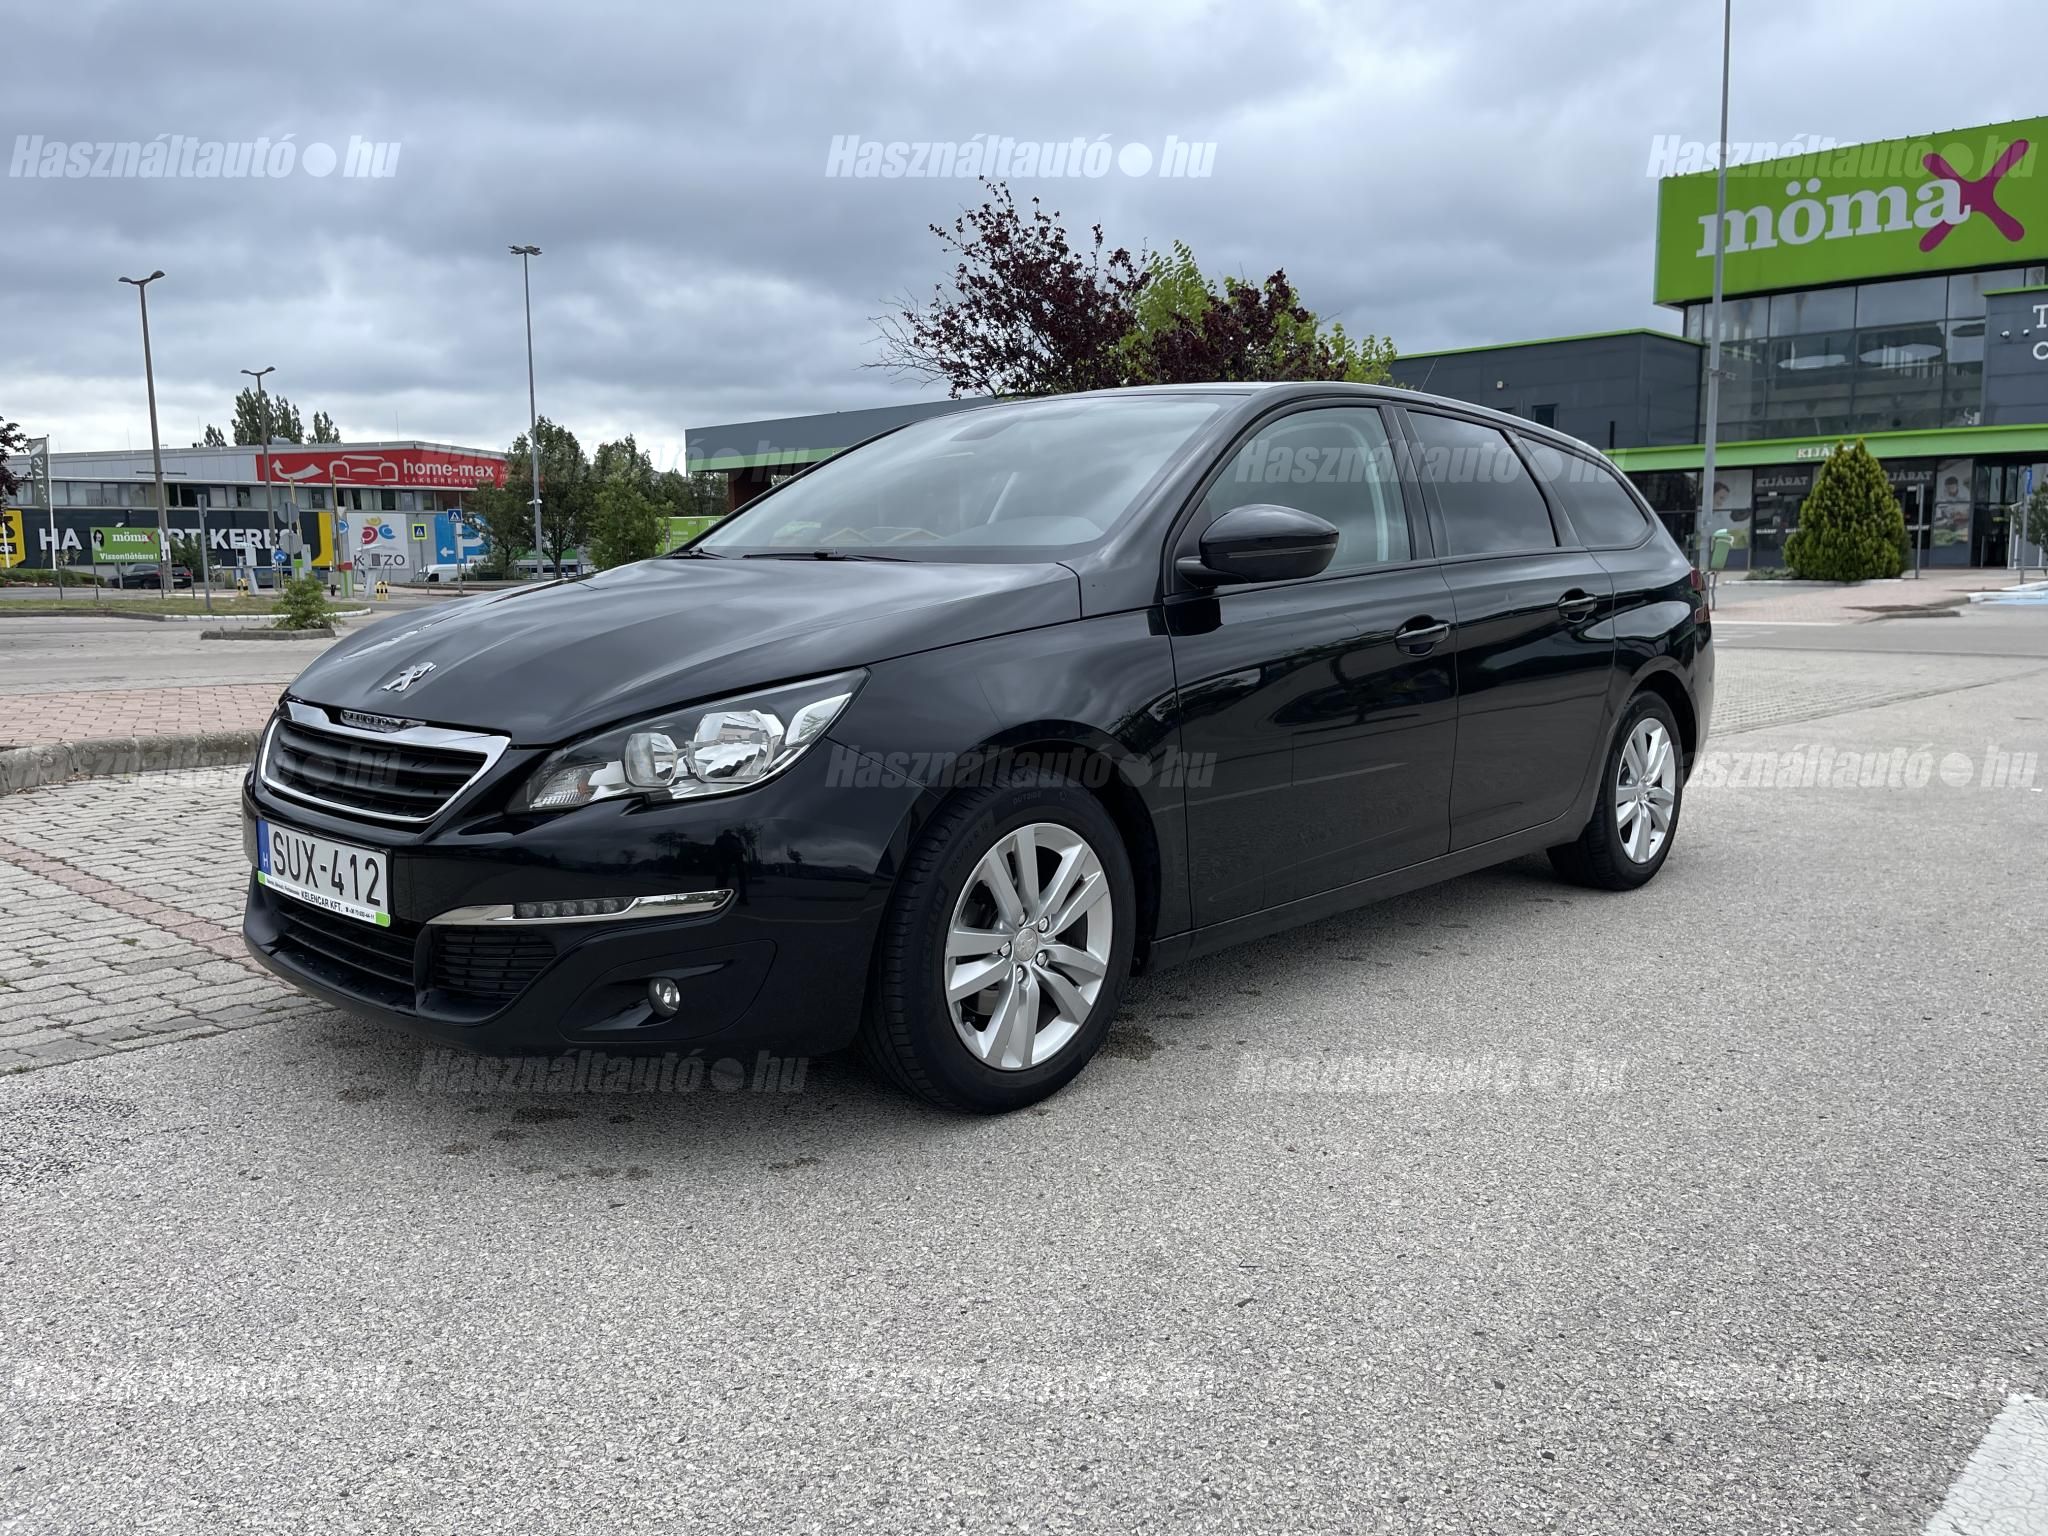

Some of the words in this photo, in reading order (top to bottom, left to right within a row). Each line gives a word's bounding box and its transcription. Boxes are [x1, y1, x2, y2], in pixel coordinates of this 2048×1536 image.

[1696, 139, 2030, 258] mömax
[403, 459, 493, 477] home-max
[1888, 469, 1932, 482] IJÁRAT
[1756, 475, 1808, 487] KIJÁRAT
[273, 831, 381, 907] SUX-412
[301, 890, 329, 908] KELENCAR
